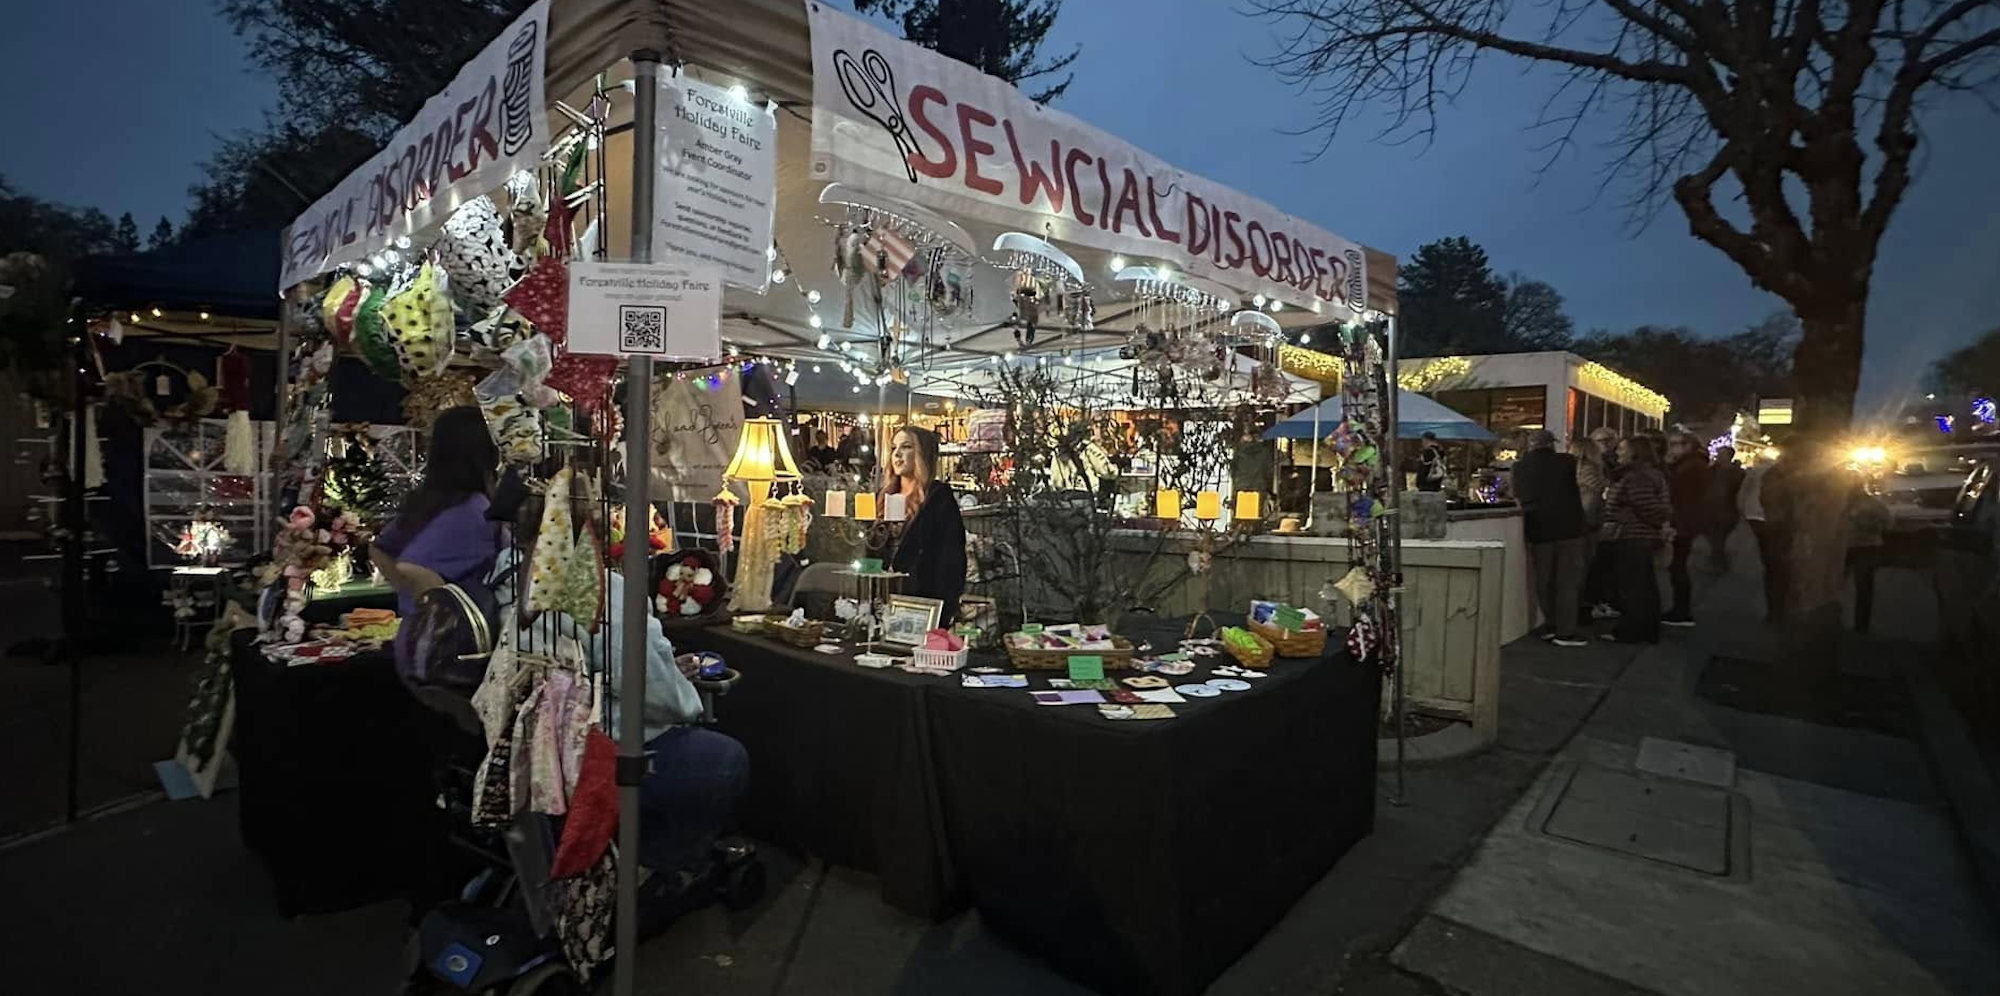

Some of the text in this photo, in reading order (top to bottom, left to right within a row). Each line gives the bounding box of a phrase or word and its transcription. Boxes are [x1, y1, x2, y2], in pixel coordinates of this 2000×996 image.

[674, 105, 762, 150] Holiday Faire
[687, 88, 753, 128] Forestville
[366, 75, 499, 236] DISORDER
[682, 148, 753, 181] Event Coordinator
[695, 138, 743, 165] Amber Gray
[908, 84, 1347, 302] SEWCIAL DISORDER
[579, 276, 710, 291] Forestville Holiday Faire
